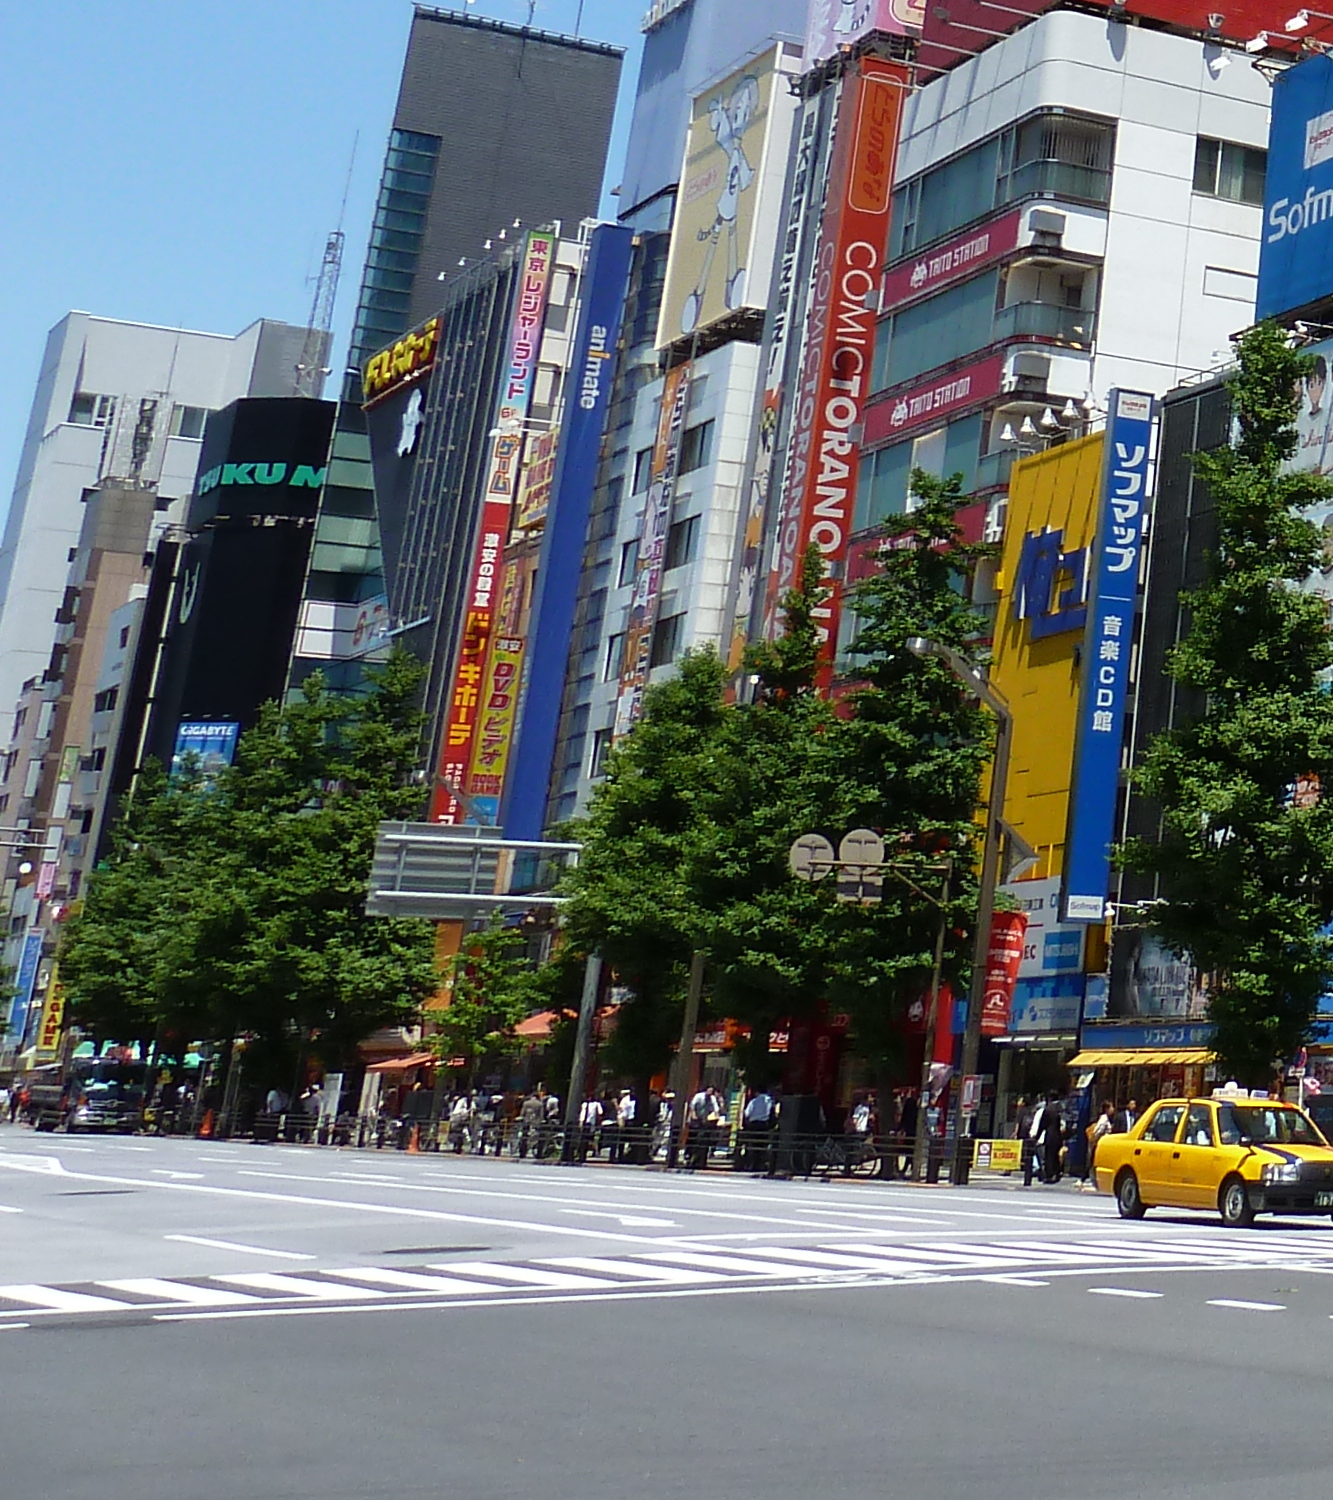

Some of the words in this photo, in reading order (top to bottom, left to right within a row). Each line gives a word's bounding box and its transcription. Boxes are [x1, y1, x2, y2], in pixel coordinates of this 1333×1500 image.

[928, 248, 952, 273] TAITO
[953, 234, 991, 264] STATION
[507, 239, 548, 402] 東京レジャーランド
[580, 325, 607, 409] animate
[909, 395, 933, 417] TAITO
[934, 375, 971, 411] STATION
[488, 434, 520, 495] ゲーム
[1106, 442, 1146, 573] ソフマップ
[487, 661, 515, 712] DVD
[1092, 615, 1123, 733] 音楽CD館
[180, 724, 235, 737] GIGABYTE
[42, 1002, 62, 1049] GAME
